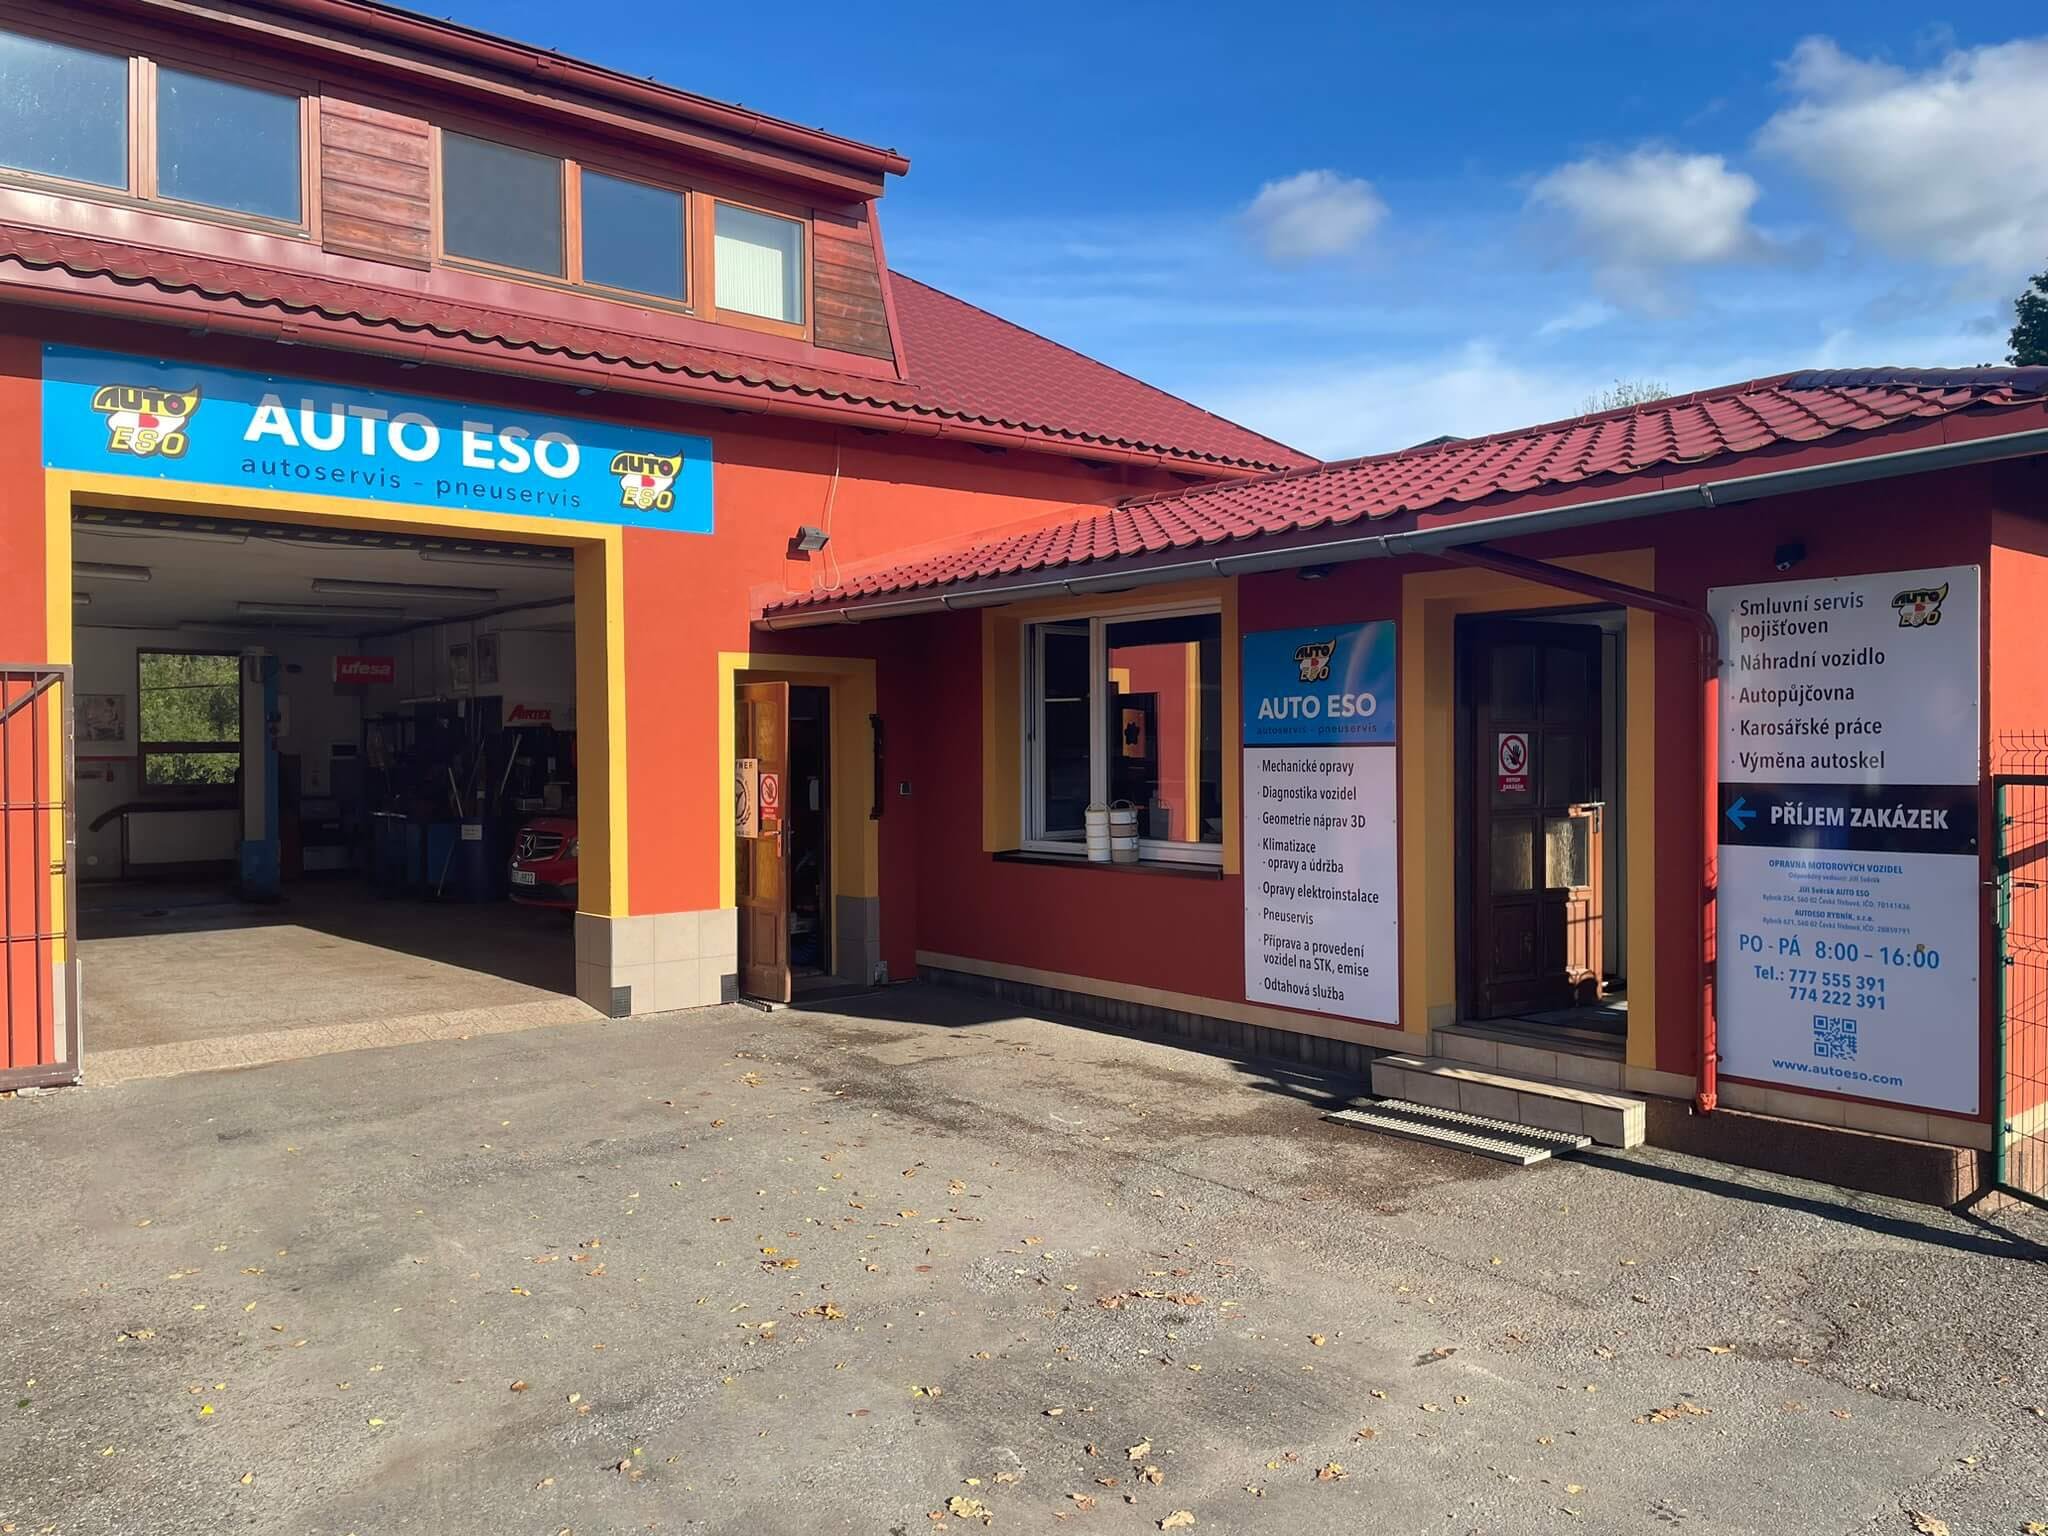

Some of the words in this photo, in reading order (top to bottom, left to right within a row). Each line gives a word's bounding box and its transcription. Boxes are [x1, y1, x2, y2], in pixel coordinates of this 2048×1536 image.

[97, 387, 186, 415] AUTO
[111, 427, 185, 455] ESO
[243, 394, 440, 462] AUTO
[462, 421, 580, 479] ESO
[613, 455, 674, 476] AUTO
[241, 458, 401, 489] autoservis
[436, 479, 581, 508] pneuservis
[622, 486, 673, 509] ESO
[1740, 594, 1810, 617] Smluvní
[1814, 591, 1864, 613] servis
[1894, 591, 1940, 605] AUTO
[1740, 618, 1829, 643] pojišťoven
[1296, 645, 1330, 659] AUTO
[1740, 650, 1817, 671] Náhradní
[1821, 647, 1885, 667] vozidlo
[341, 662, 392, 676] ufesa
[1258, 695, 1321, 720] AUTO
[1327, 693, 1377, 718] ESO
[1740, 684, 1855, 707] Autopůjčovna
[1257, 724, 1307, 736] autoservis
[1318, 723, 1377, 736] pneuservis
[1740, 716, 1829, 737] Karosářské
[1835, 719, 1883, 740] práce
[1262, 759, 1317, 773] Mechanické
[1319, 762, 1354, 776] opravy
[1740, 750, 1806, 773] Výměna
[1811, 750, 1885, 770] autoskel
[1262, 785, 1318, 801] Diagnostika
[1320, 786, 1357, 801] vozidel
[1262, 811, 1311, 826] Geometrie
[1313, 814, 1348, 830] náprav
[1351, 815, 1366, 828] 3D
[1771, 802, 1844, 827] PŘÍJEM
[1850, 804, 1949, 830] ZAKÁZEK
[1262, 837, 1317, 853] Klimatizace
[1268, 858, 1299, 874] opravy
[1301, 860, 1307, 871] a
[1309, 858, 1344, 873] údržba
[1769, 859, 1807, 870] OPRAVNA
[1808, 860, 1867, 873] MOTOROVÝCH
[1867, 864, 1904, 875] VOZIDEL
[1262, 881, 1295, 899] Opravy
[1297, 884, 1379, 903] elektroinstalace
[1263, 907, 1314, 925] Pneuservis
[1263, 933, 1301, 951] Příprava
[1304, 940, 1310, 951] a
[1312, 942, 1365, 958] provedení
[1739, 934, 1763, 953] PO
[1778, 935, 1801, 957] PÁ
[1815, 941, 1858, 962] 8:00
[1880, 946, 1940, 969] 16:00
[1263, 953, 1297, 967] vozidel
[1300, 958, 1311, 970] na
[1314, 957, 1335, 974] STK,
[1337, 962, 1369, 977] emise
[1264, 977, 1310, 996] Odtahová
[1312, 984, 1345, 1001] služba
[1754, 965, 1784, 982] Tel.:
[1789, 968, 1817, 985] 777
[1821, 971, 1851, 989] 555
[1855, 975, 1885, 993] 391
[1789, 986, 1817, 1003] 774
[1821, 990, 1851, 1006] 222
[1855, 993, 1885, 1010] 391
[1772, 1058, 1904, 1087] www.autoeso.com
